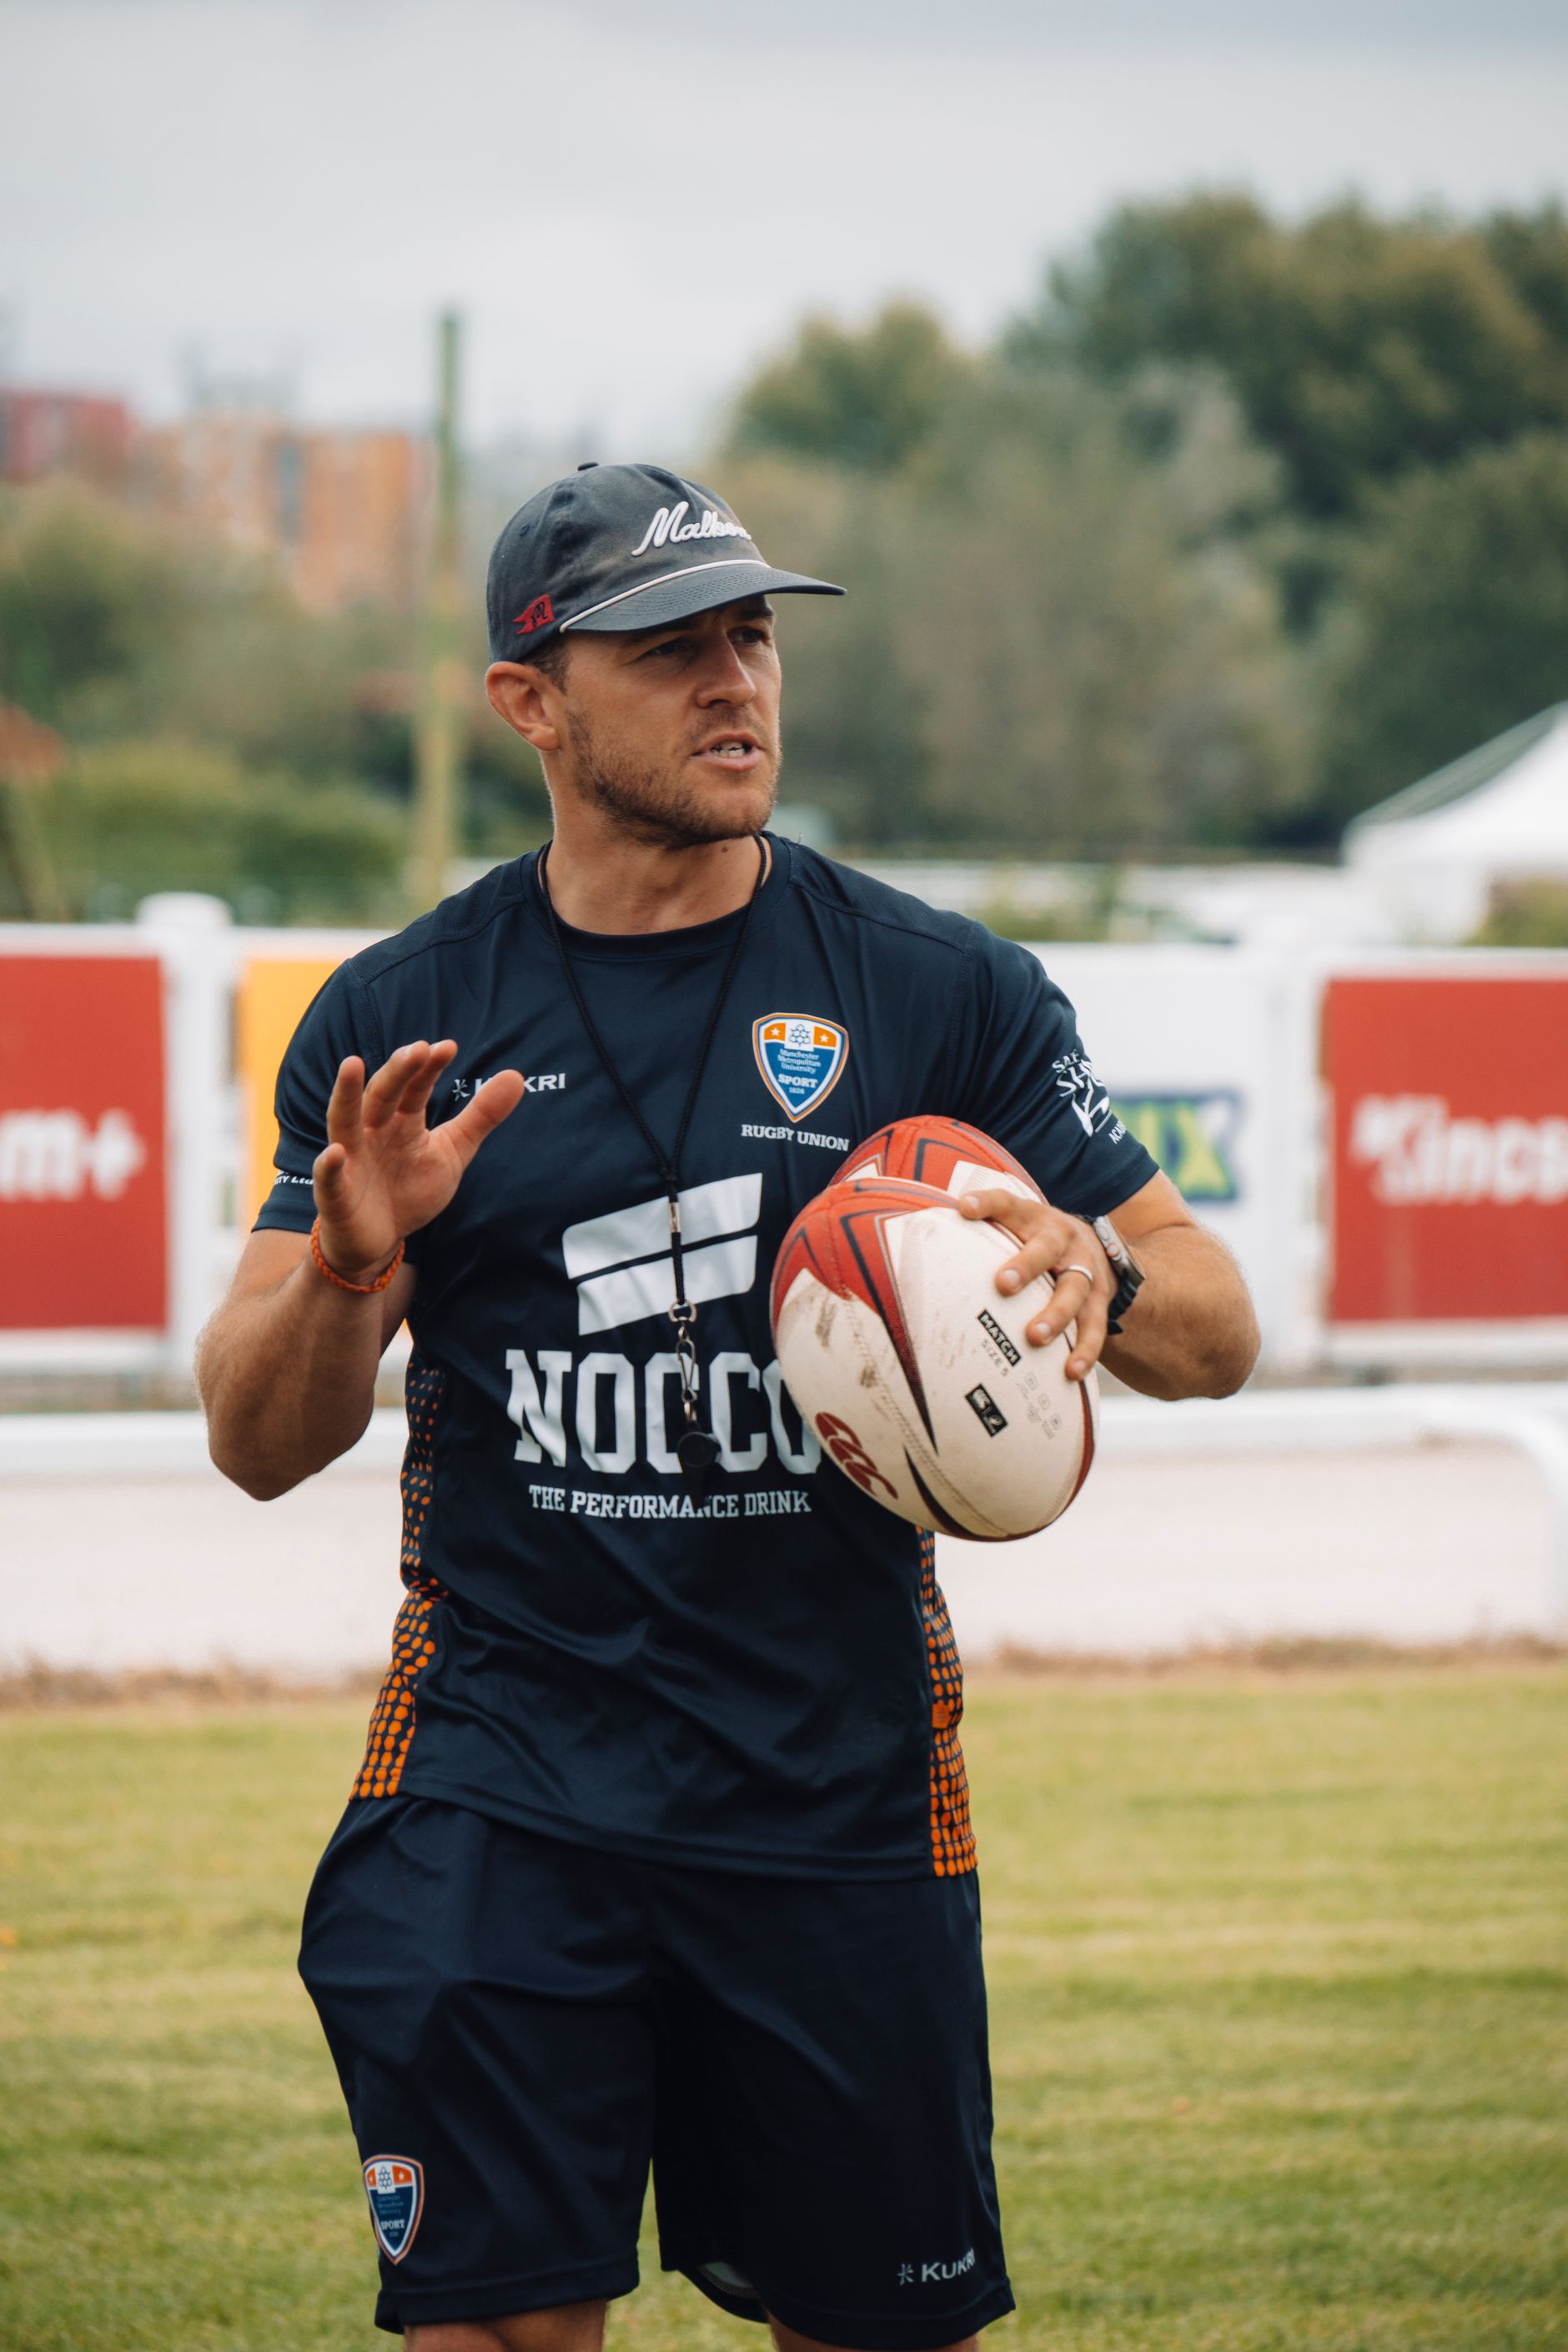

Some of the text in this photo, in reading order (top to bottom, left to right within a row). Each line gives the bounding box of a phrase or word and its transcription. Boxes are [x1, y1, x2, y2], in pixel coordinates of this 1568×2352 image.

[777, 1073, 818, 1088] SPORT
[741, 1123, 850, 1151] RUGBY UNION
[979, 1312, 1020, 1364] MATCH
[505, 1348, 822, 1475] NOCCO
[529, 1484, 566, 1513] THE
[744, 1490, 812, 1516] DRINK
